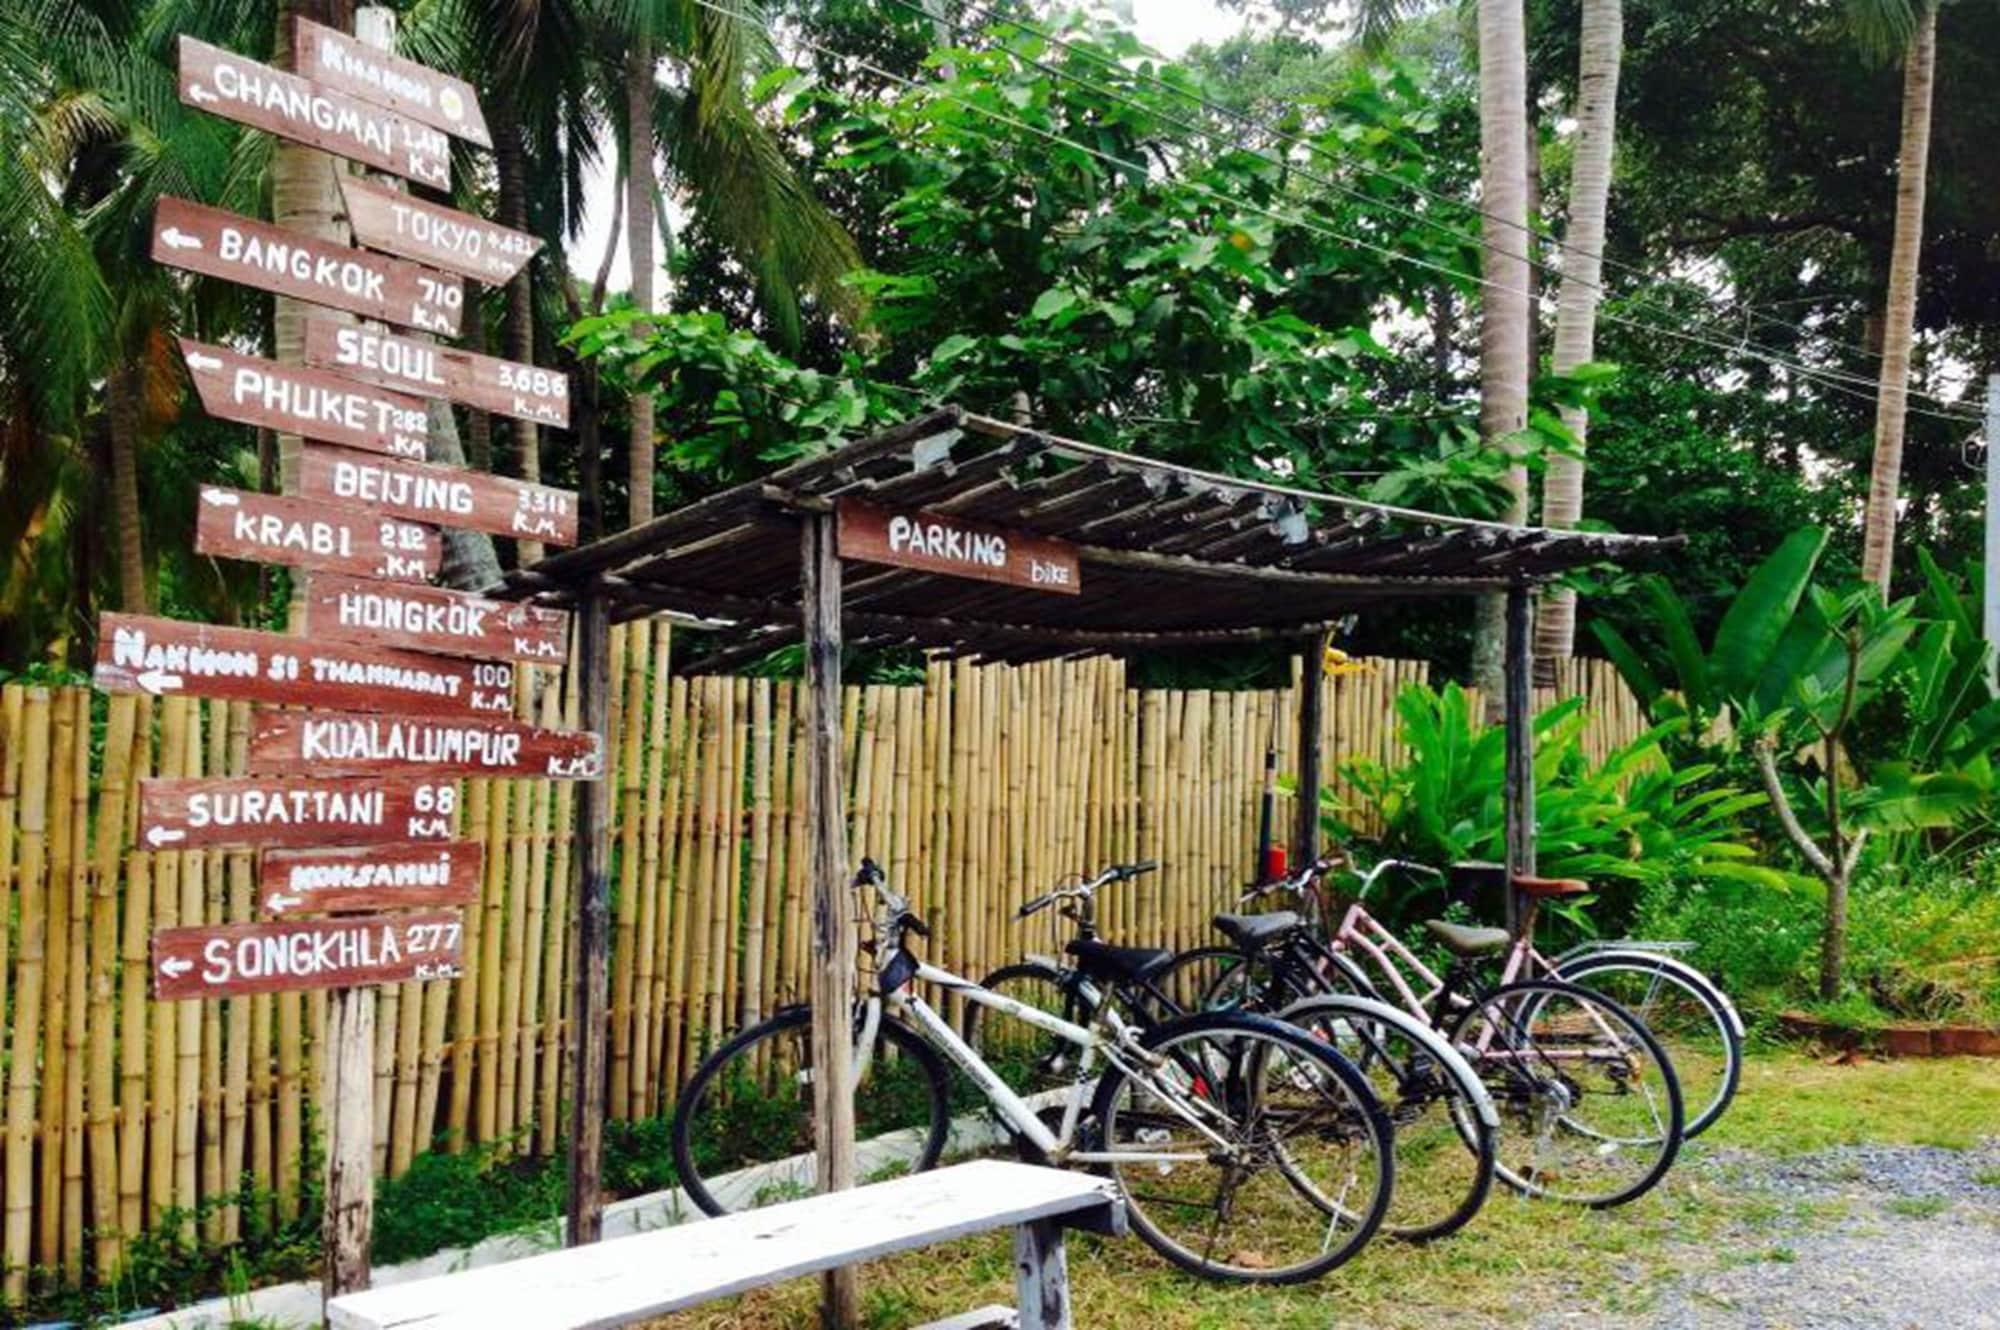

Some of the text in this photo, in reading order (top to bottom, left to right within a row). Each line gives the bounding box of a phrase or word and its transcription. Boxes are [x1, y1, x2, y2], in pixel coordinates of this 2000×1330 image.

[213, 64, 393, 154] CHANGMAI
[391, 204, 481, 257] TOKYO
[220, 228, 463, 309] BANGKOK 710
[336, 328, 445, 385] SEOUL
[233, 368, 395, 435] PHUKET
[333, 461, 474, 514] BEIJING
[233, 511, 352, 558] KRABI
[888, 515, 1006, 567] PARKING
[338, 592, 487, 637] HONGKOK
[471, 663, 511, 689] 100
[414, 784, 456, 816] 68
[201, 922, 463, 985] SONGKHLA 277
